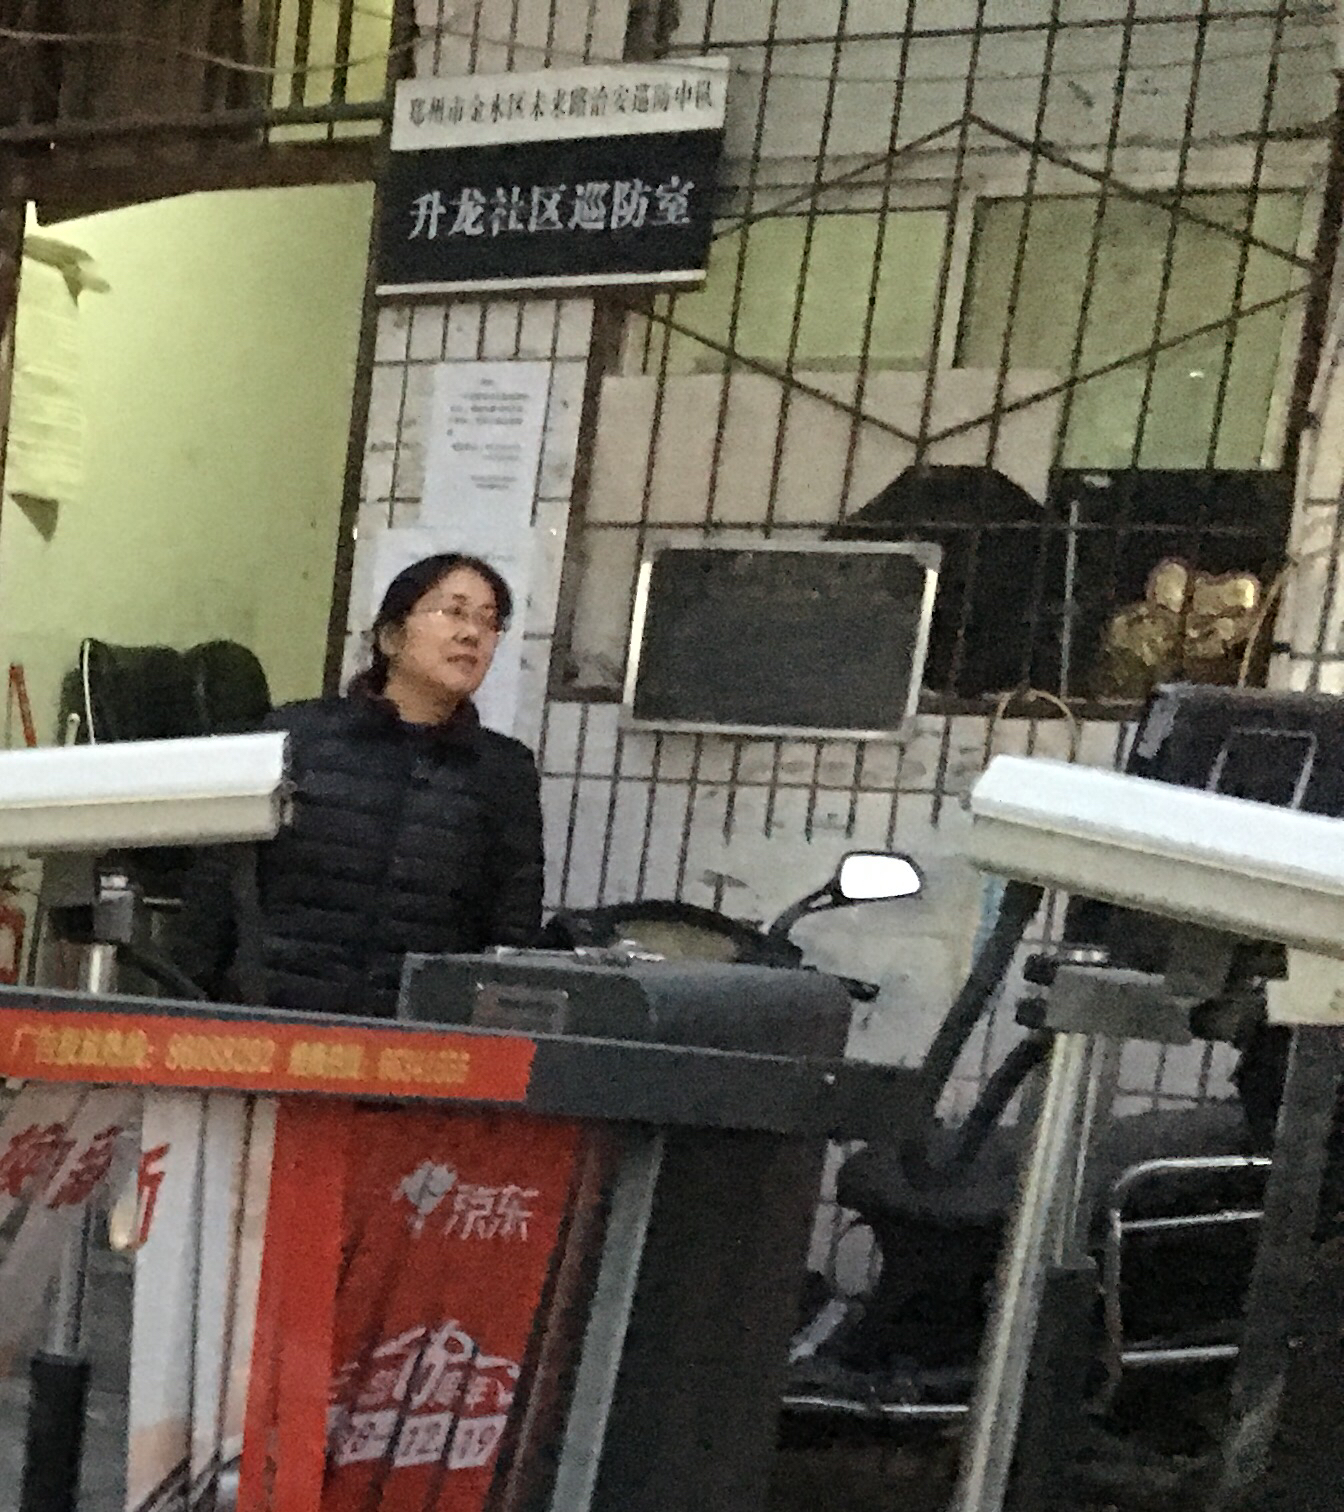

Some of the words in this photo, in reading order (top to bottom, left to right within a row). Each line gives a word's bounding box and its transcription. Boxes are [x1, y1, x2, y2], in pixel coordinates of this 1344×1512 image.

[408, 175, 696, 240] 升龙社区巡防室
